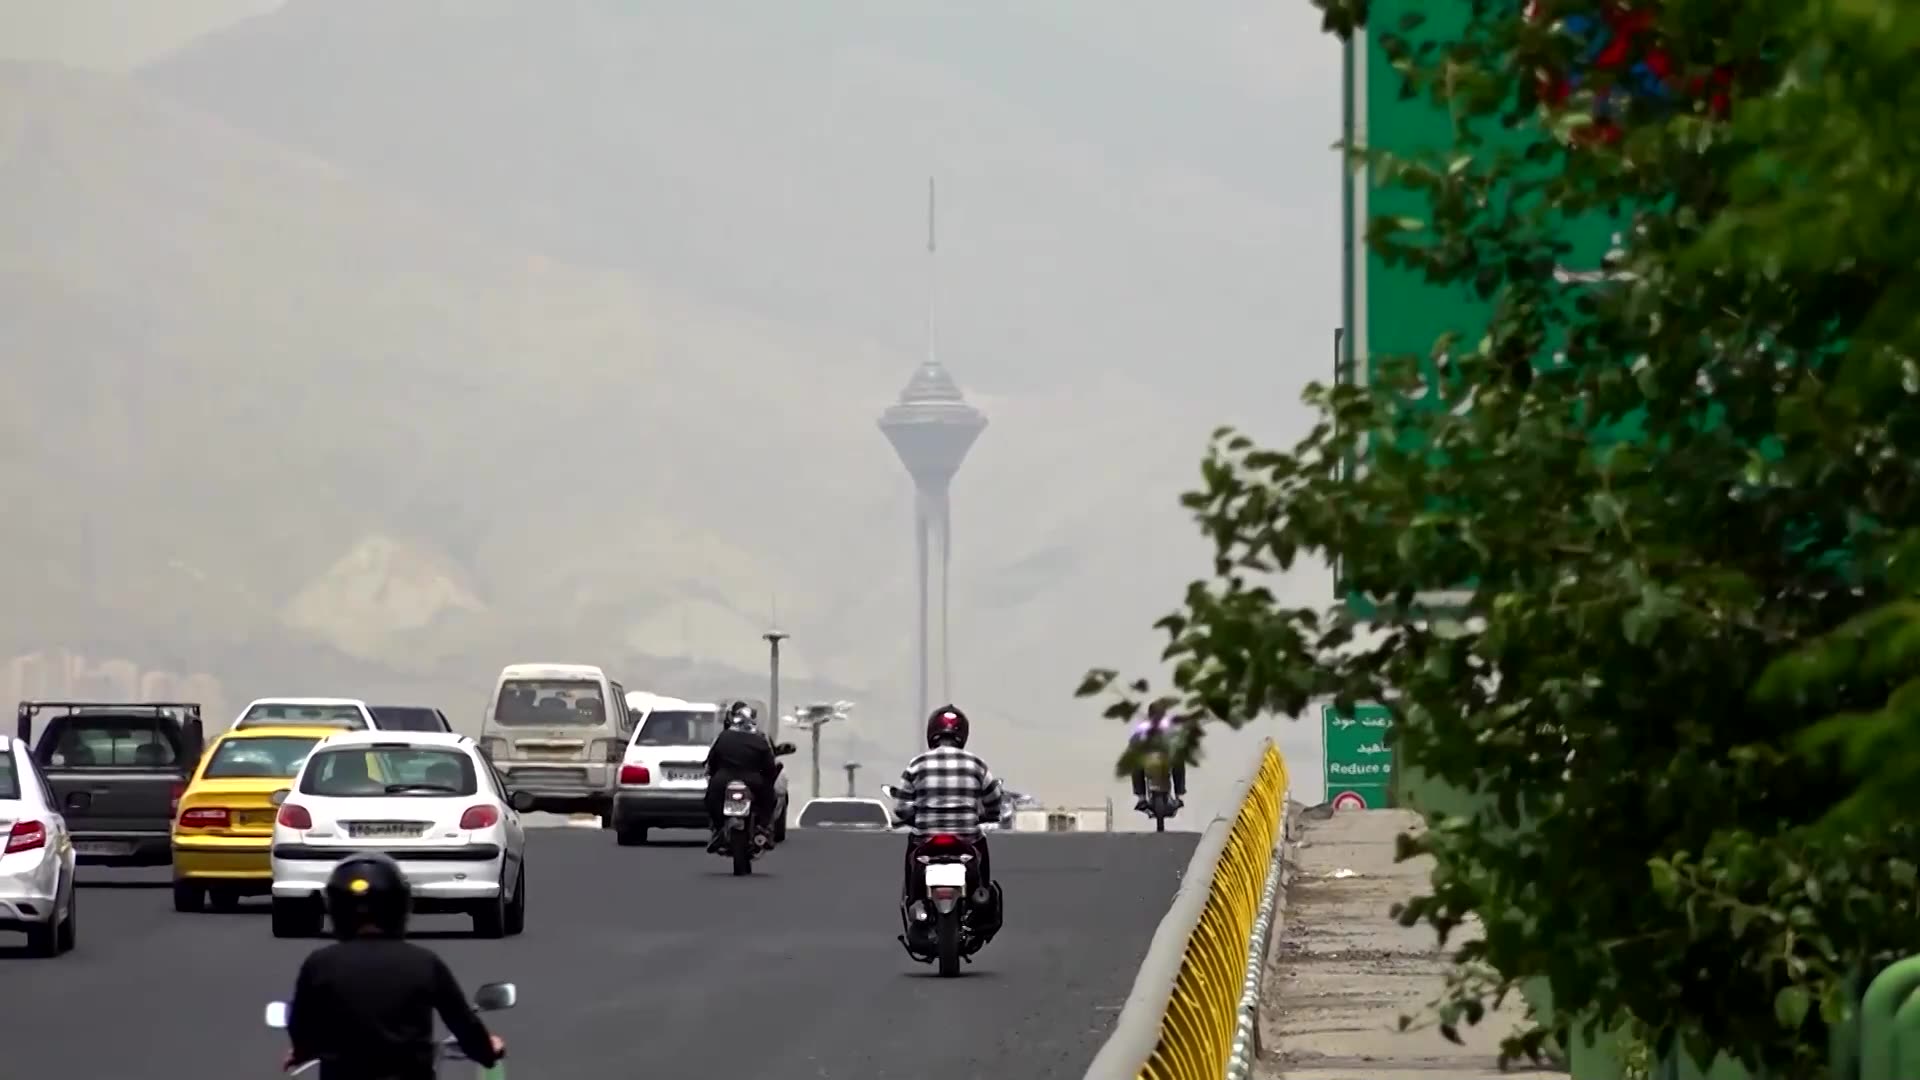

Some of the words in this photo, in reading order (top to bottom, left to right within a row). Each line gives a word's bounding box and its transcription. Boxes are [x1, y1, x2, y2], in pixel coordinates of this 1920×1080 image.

[1362, 717, 1394, 729] رعت
[1356, 741, 1392, 755] اهید
[1330, 762, 1380, 775] Reduce
